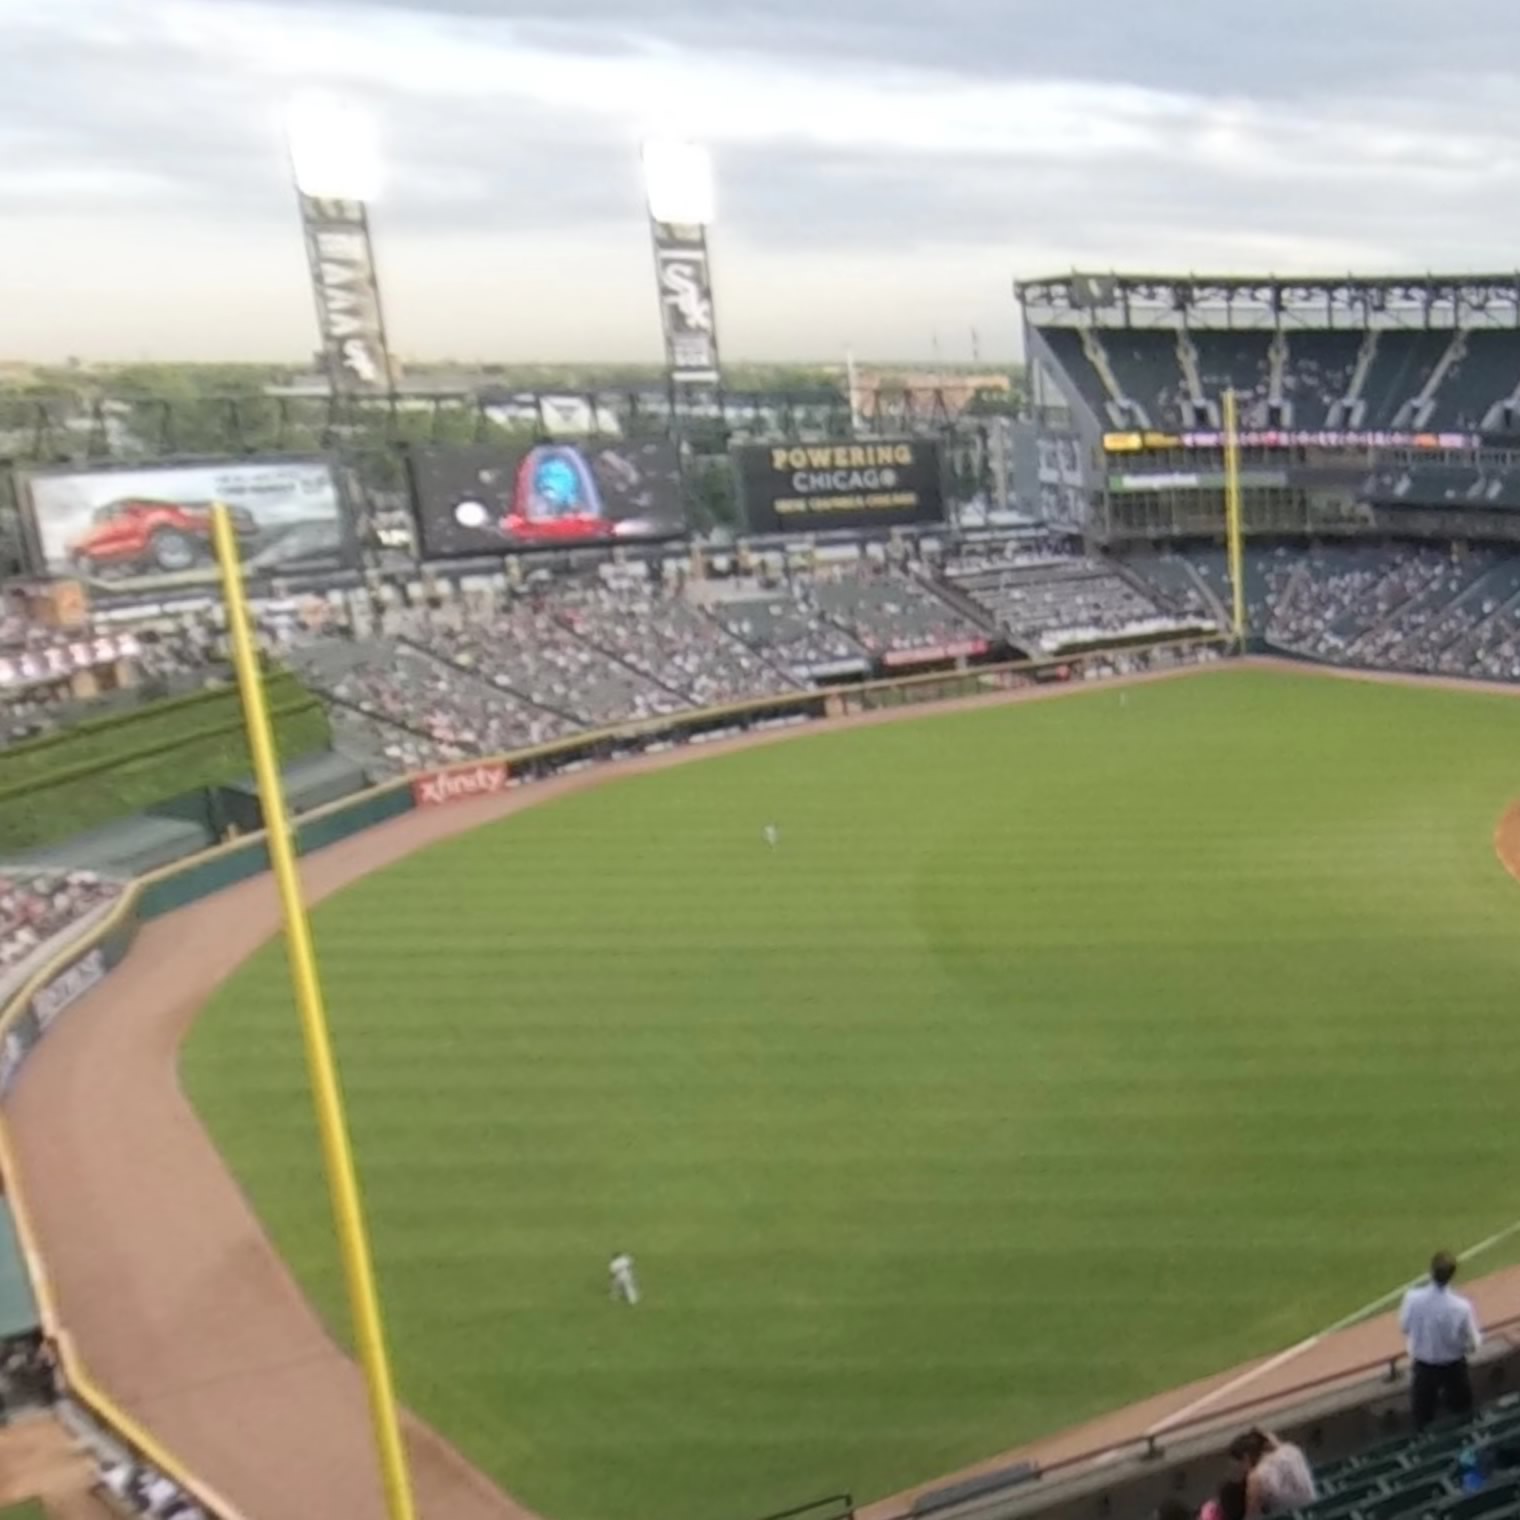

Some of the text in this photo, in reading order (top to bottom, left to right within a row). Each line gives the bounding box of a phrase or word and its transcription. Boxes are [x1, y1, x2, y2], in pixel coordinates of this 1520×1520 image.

[771, 446, 913, 470] POWERING
[792, 468, 897, 492] CHICAGO
[419, 766, 507, 803] xfinity
